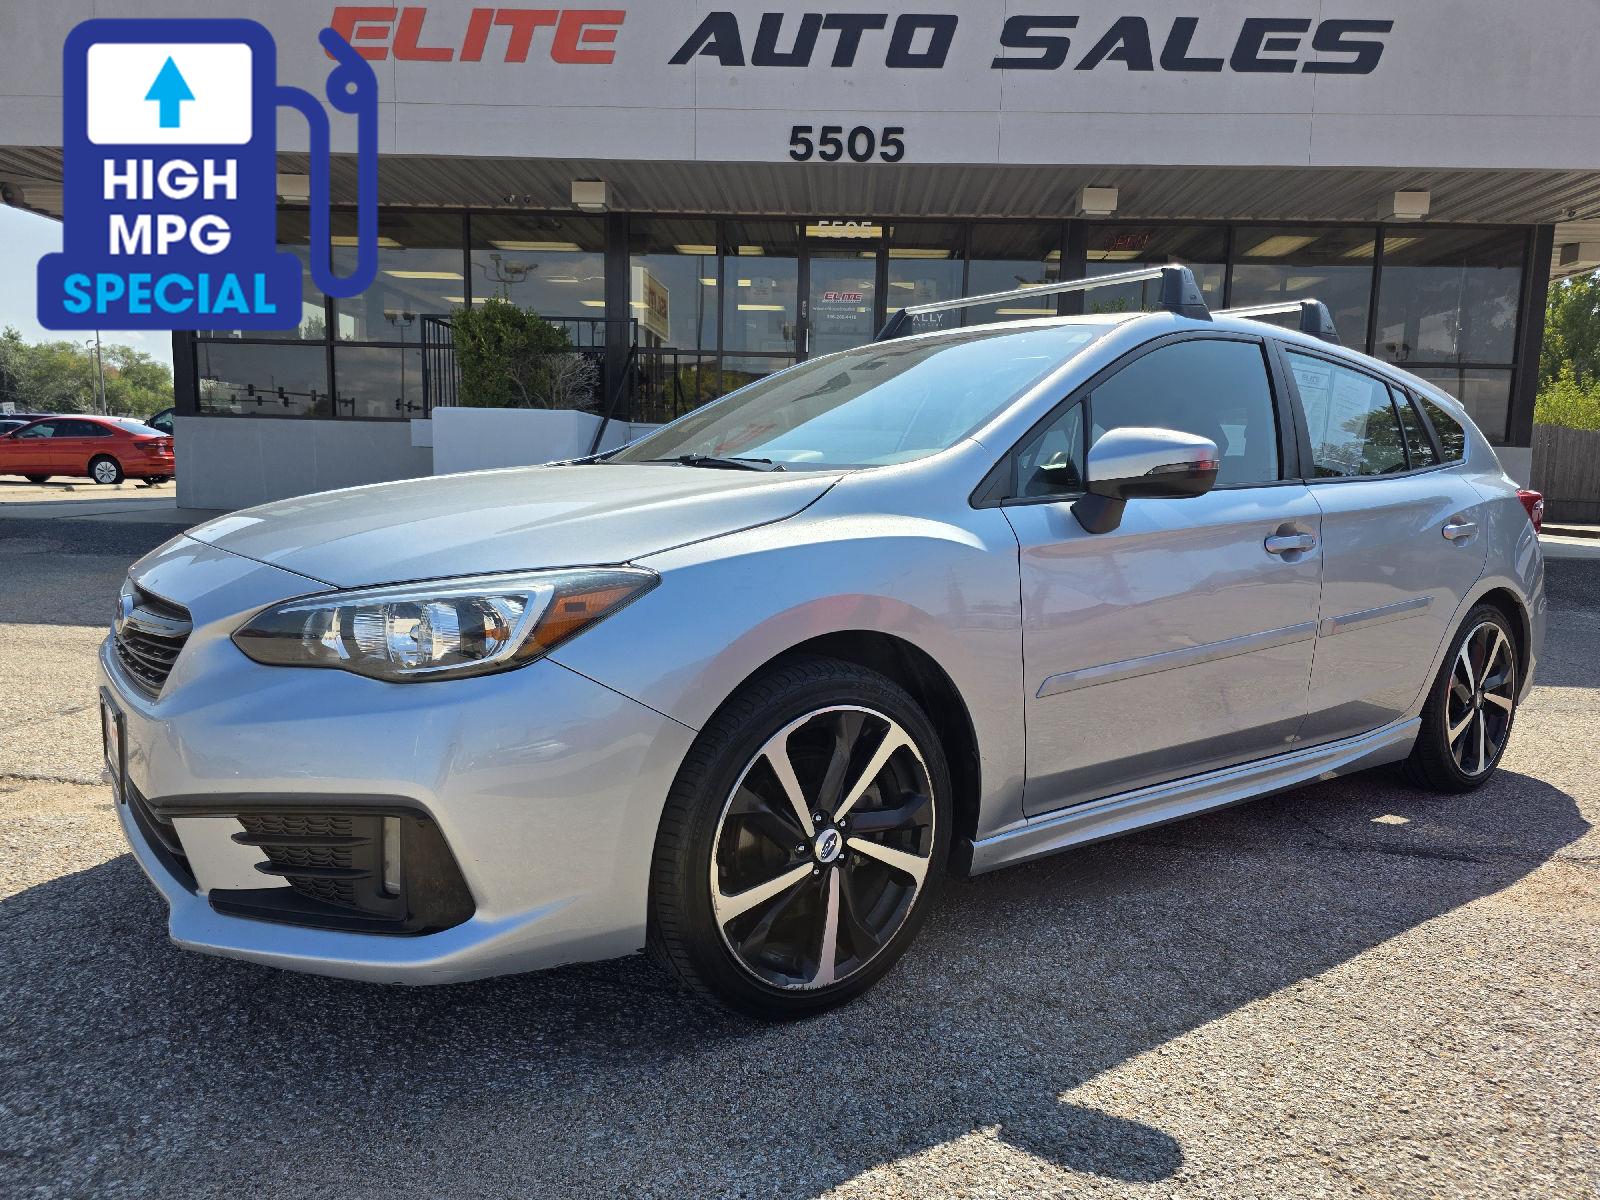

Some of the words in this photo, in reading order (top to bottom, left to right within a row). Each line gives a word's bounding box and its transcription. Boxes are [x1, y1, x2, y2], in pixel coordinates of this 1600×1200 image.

[324, 7, 627, 64] ELITE
[668, 10, 959, 68] AUTO
[991, 15, 1395, 75] SALES
[789, 125, 905, 163] 5505
[818, 220, 872, 239] 5505
[824, 291, 864, 301] ELITE
[912, 313, 944, 322] ALLY
